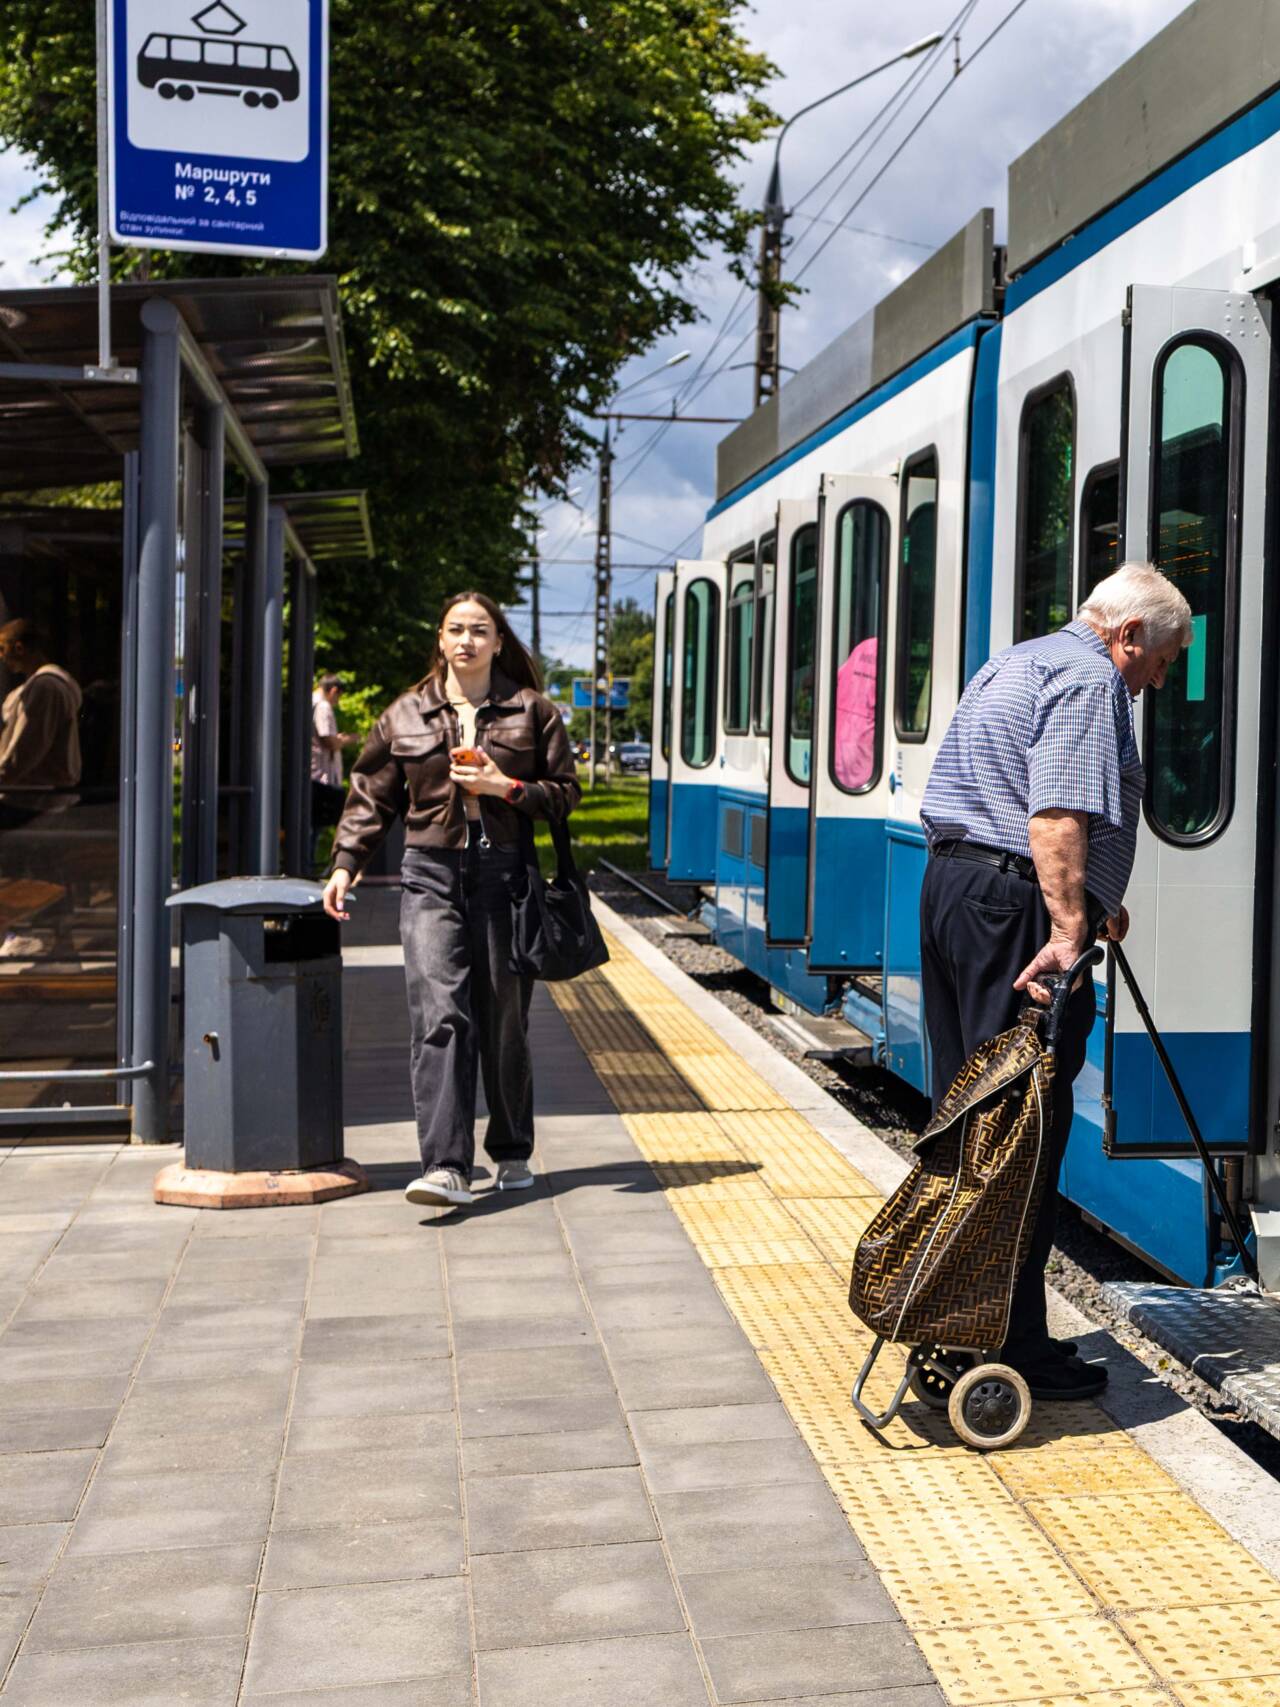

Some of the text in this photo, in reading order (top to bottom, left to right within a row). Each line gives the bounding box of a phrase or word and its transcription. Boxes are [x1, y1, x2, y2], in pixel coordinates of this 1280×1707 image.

[175, 162, 271, 187] Маршрути
[175, 184, 257, 207] № 2, 4, 5
